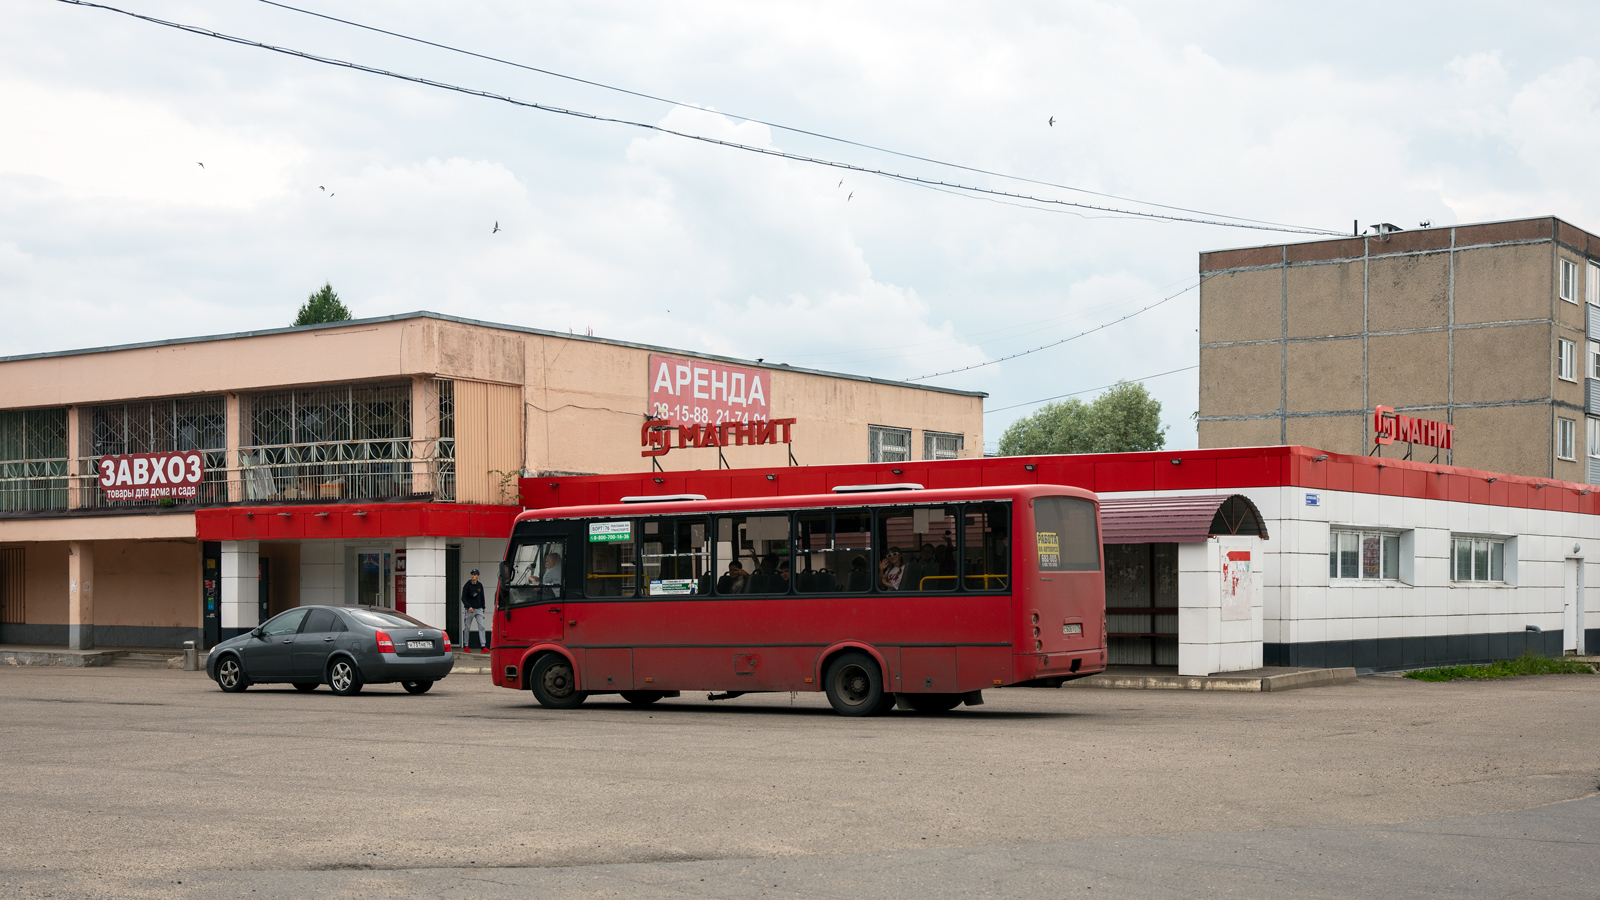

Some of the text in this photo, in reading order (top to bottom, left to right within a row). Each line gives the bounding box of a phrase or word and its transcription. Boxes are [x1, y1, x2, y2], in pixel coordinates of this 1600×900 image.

[653, 362, 766, 408] АРЕНДА
[678, 418, 796, 449] МАГНИТ
[1396, 414, 1455, 450] МАГНИТ
[101, 454, 202, 486] ЗАВХОЗ
[107, 486, 196, 500] товары для дома и сада
[1038, 534, 1058, 544] РАБОТА
